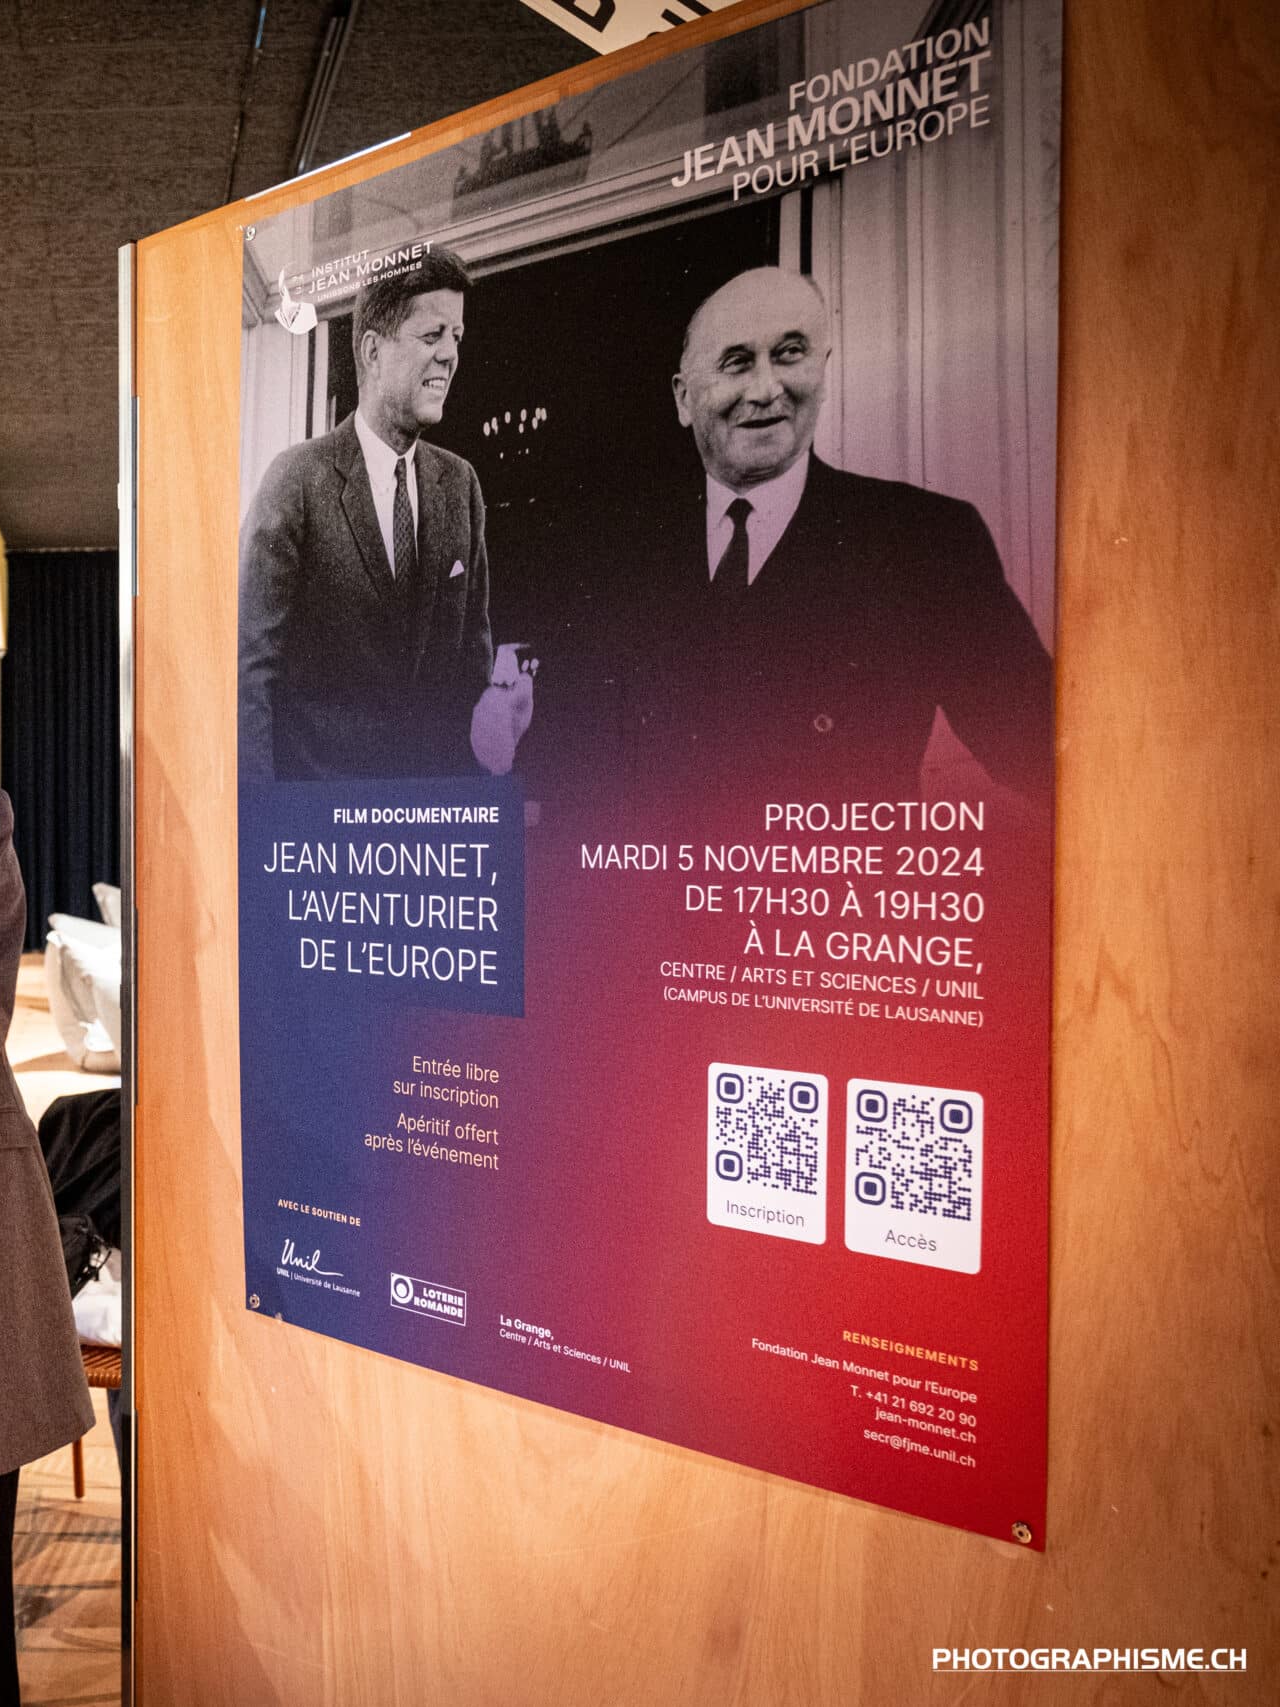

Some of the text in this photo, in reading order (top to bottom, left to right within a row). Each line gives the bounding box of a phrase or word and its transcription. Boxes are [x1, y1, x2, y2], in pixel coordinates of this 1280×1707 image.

[789, 17, 989, 110] FONDATION
[671, 51, 991, 188] JEAN MONNET
[733, 150, 819, 200] POUR
[308, 241, 434, 294] JEAN MONNET
[312, 250, 370, 277] INSTITUT
[362, 276, 378, 286] LES
[380, 261, 422, 280] HOMMES
[334, 807, 499, 823] FILM DOCUMENTAIRE
[765, 802, 984, 831] PROJECTION
[264, 842, 497, 886] JEAN MONNET,
[581, 844, 984, 876] MARDI 5 NOVEMBRE 2024
[685, 881, 984, 922] DE 17H30 À 19H30
[300, 938, 336, 971] DE
[744, 920, 982, 974] À LA GRANGE,
[660, 961, 984, 999] CENTRE / ARTS ET SCIENCES / UNIL
[663, 987, 727, 1005] (CAMPUS
[732, 993, 750, 1007] DE
[859, 1003, 880, 1018] DE
[884, 1005, 983, 1028] LAUSANNE)
[413, 1056, 499, 1083] Entrée libre
[393, 1080, 498, 1108] sur inscription
[364, 1133, 403, 1152] après
[397, 1112, 498, 1145] Apéritif offert
[278, 1199, 361, 1226] AVEC LE SOUTIEN DE
[727, 1200, 805, 1228] Inscription
[885, 1229, 937, 1251] Accès
[281, 1239, 344, 1277] Unil
[324, 1279, 330, 1288] de
[333, 1283, 361, 1297] Lausanne
[423, 1288, 463, 1306] LOTERIE
[414, 1297, 463, 1318] ROMANDE
[500, 1314, 554, 1340] La Grange,
[499, 1329, 526, 1343] Centre
[533, 1340, 550, 1350] Arts
[553, 1345, 561, 1353] et
[563, 1346, 601, 1365] Sciences
[610, 1358, 631, 1373] UNIL
[752, 1338, 808, 1362] Fondation
[811, 1353, 840, 1369] Jean
[843, 1360, 889, 1382] Monnet
[892, 1373, 922, 1389] pour
[843, 1330, 979, 1372] RENSEIGNEMENTS
[851, 1385, 976, 1427] T. +41 21 692 20 90
[875, 1407, 976, 1443] jean-monnet.ch
[864, 1428, 976, 1468] secr@fjme.unil.ch
